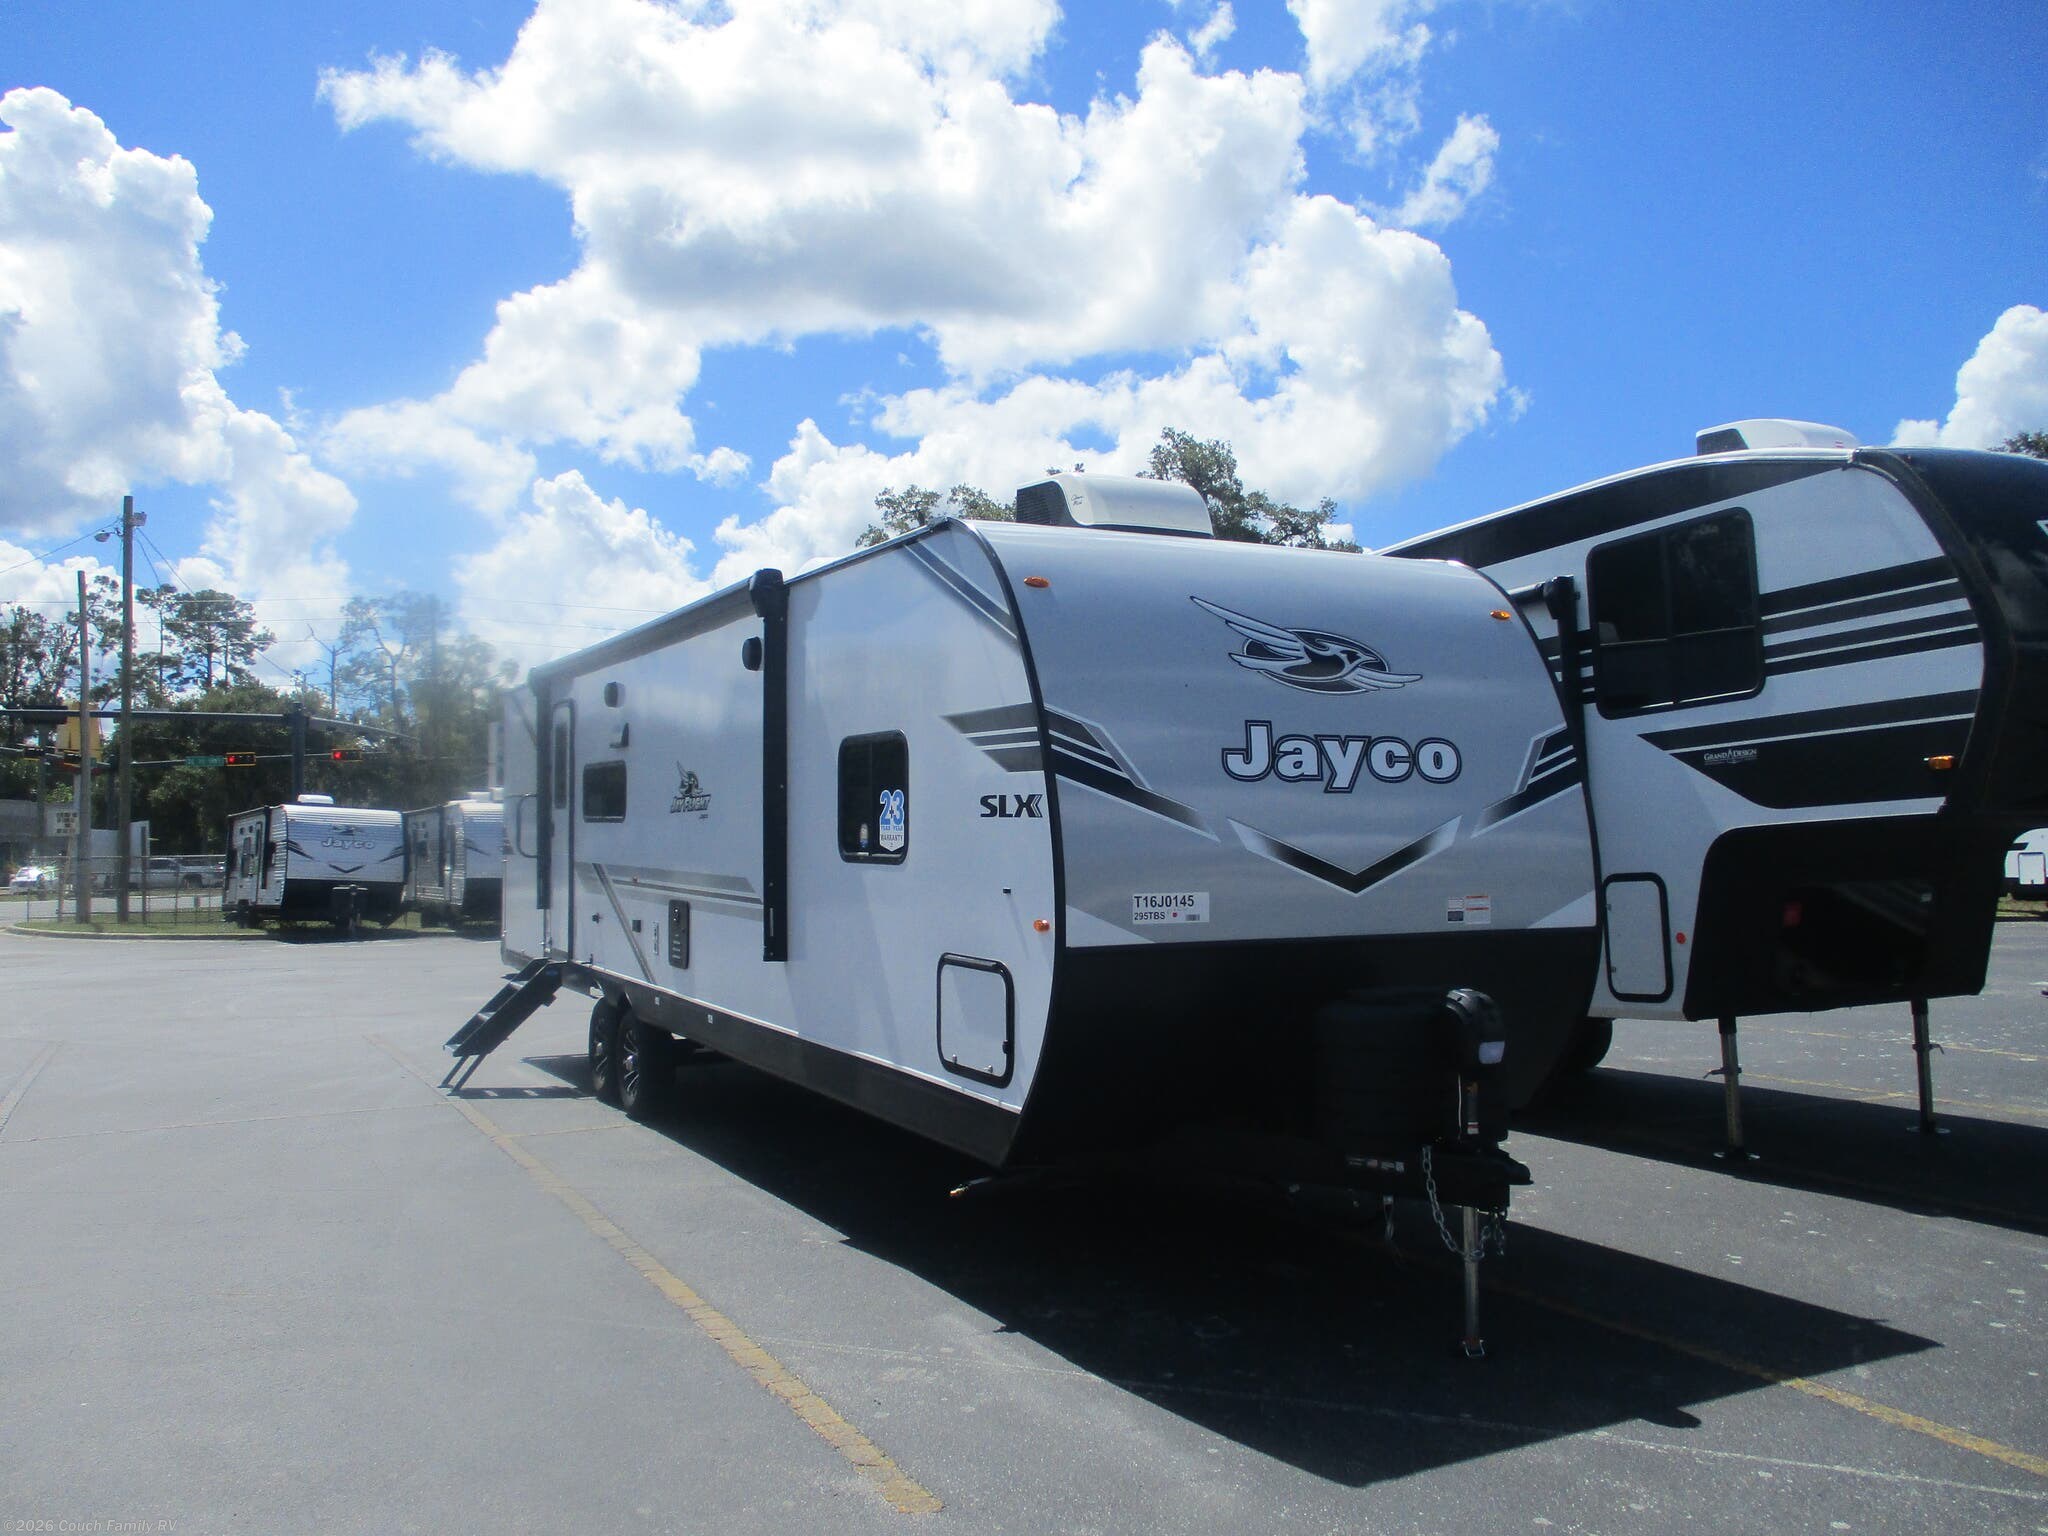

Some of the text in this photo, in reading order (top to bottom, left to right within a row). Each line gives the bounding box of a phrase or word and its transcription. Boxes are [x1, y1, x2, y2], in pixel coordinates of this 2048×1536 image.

[1221, 719, 1462, 794] Jayco
[980, 794, 1043, 818] SLX
[321, 836, 376, 850] Jayco
[1133, 894, 1195, 908] T16J0145
[1134, 911, 1166, 921] 295TBS
